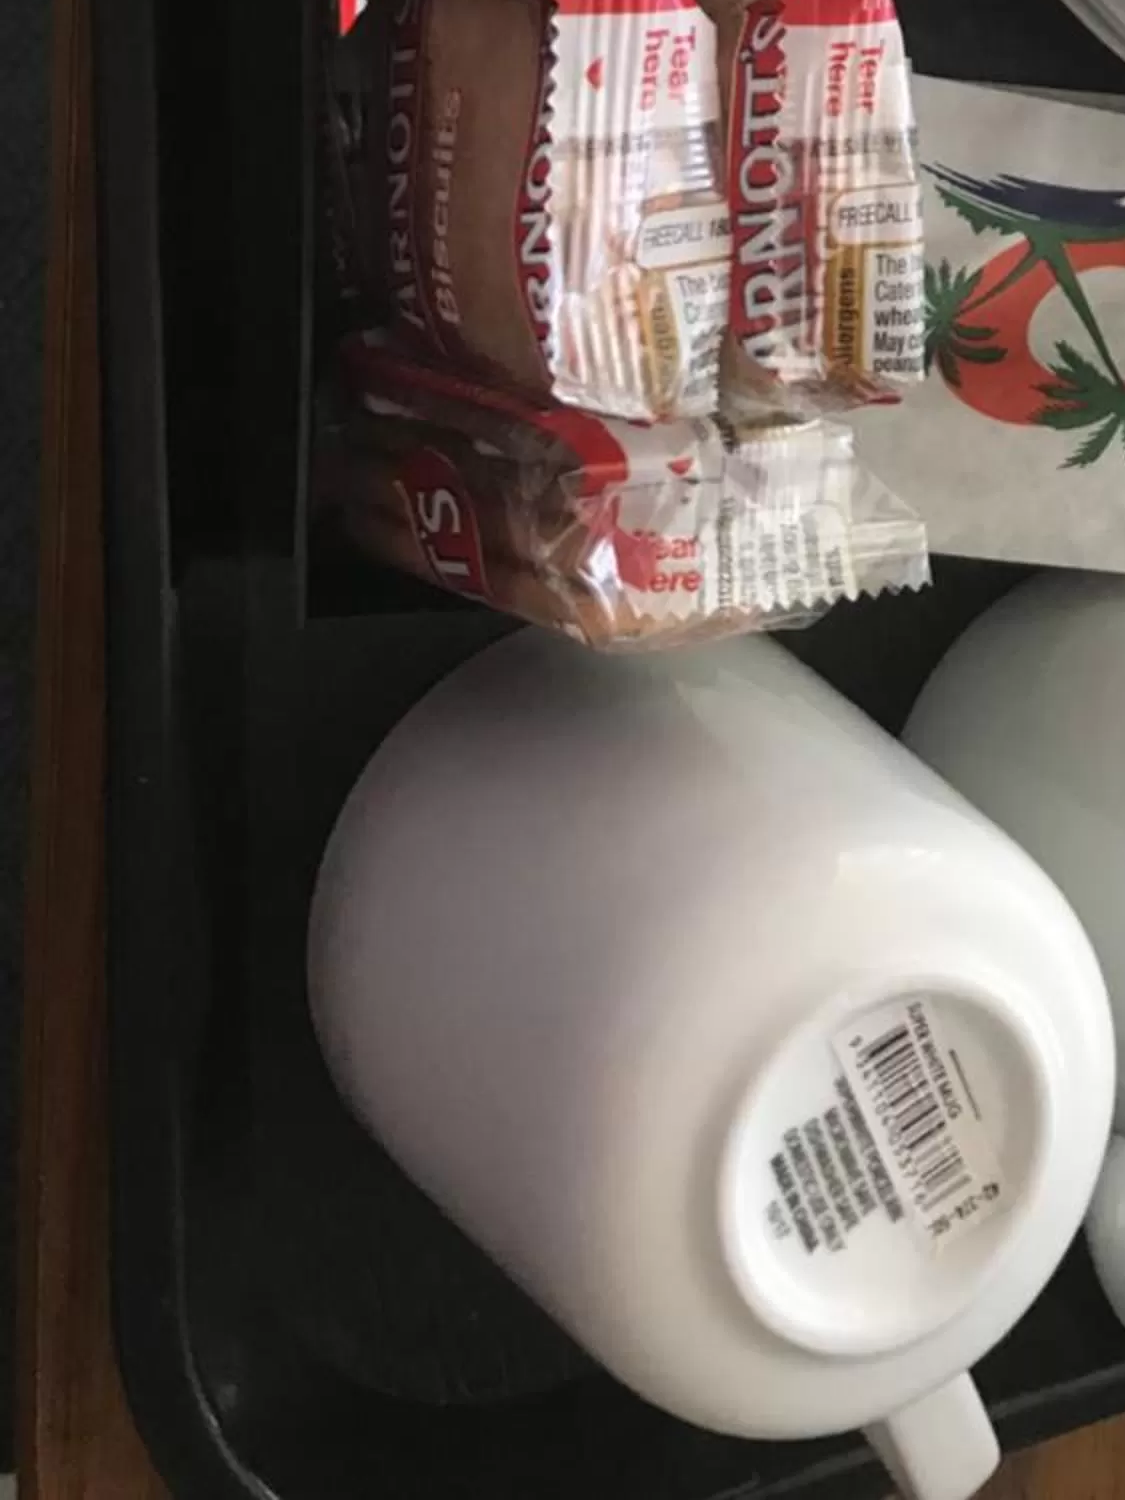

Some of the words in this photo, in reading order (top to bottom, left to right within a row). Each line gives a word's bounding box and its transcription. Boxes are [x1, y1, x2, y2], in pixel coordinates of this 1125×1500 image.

[640, 28, 670, 112] here
[667, 26, 696, 102] Tear
[826, 41, 857, 117] here
[860, 40, 885, 115] Tear
[431, 88, 462, 325] Biscuits
[875, 253, 908, 276] The
[937, 1081, 963, 1120] MUG
